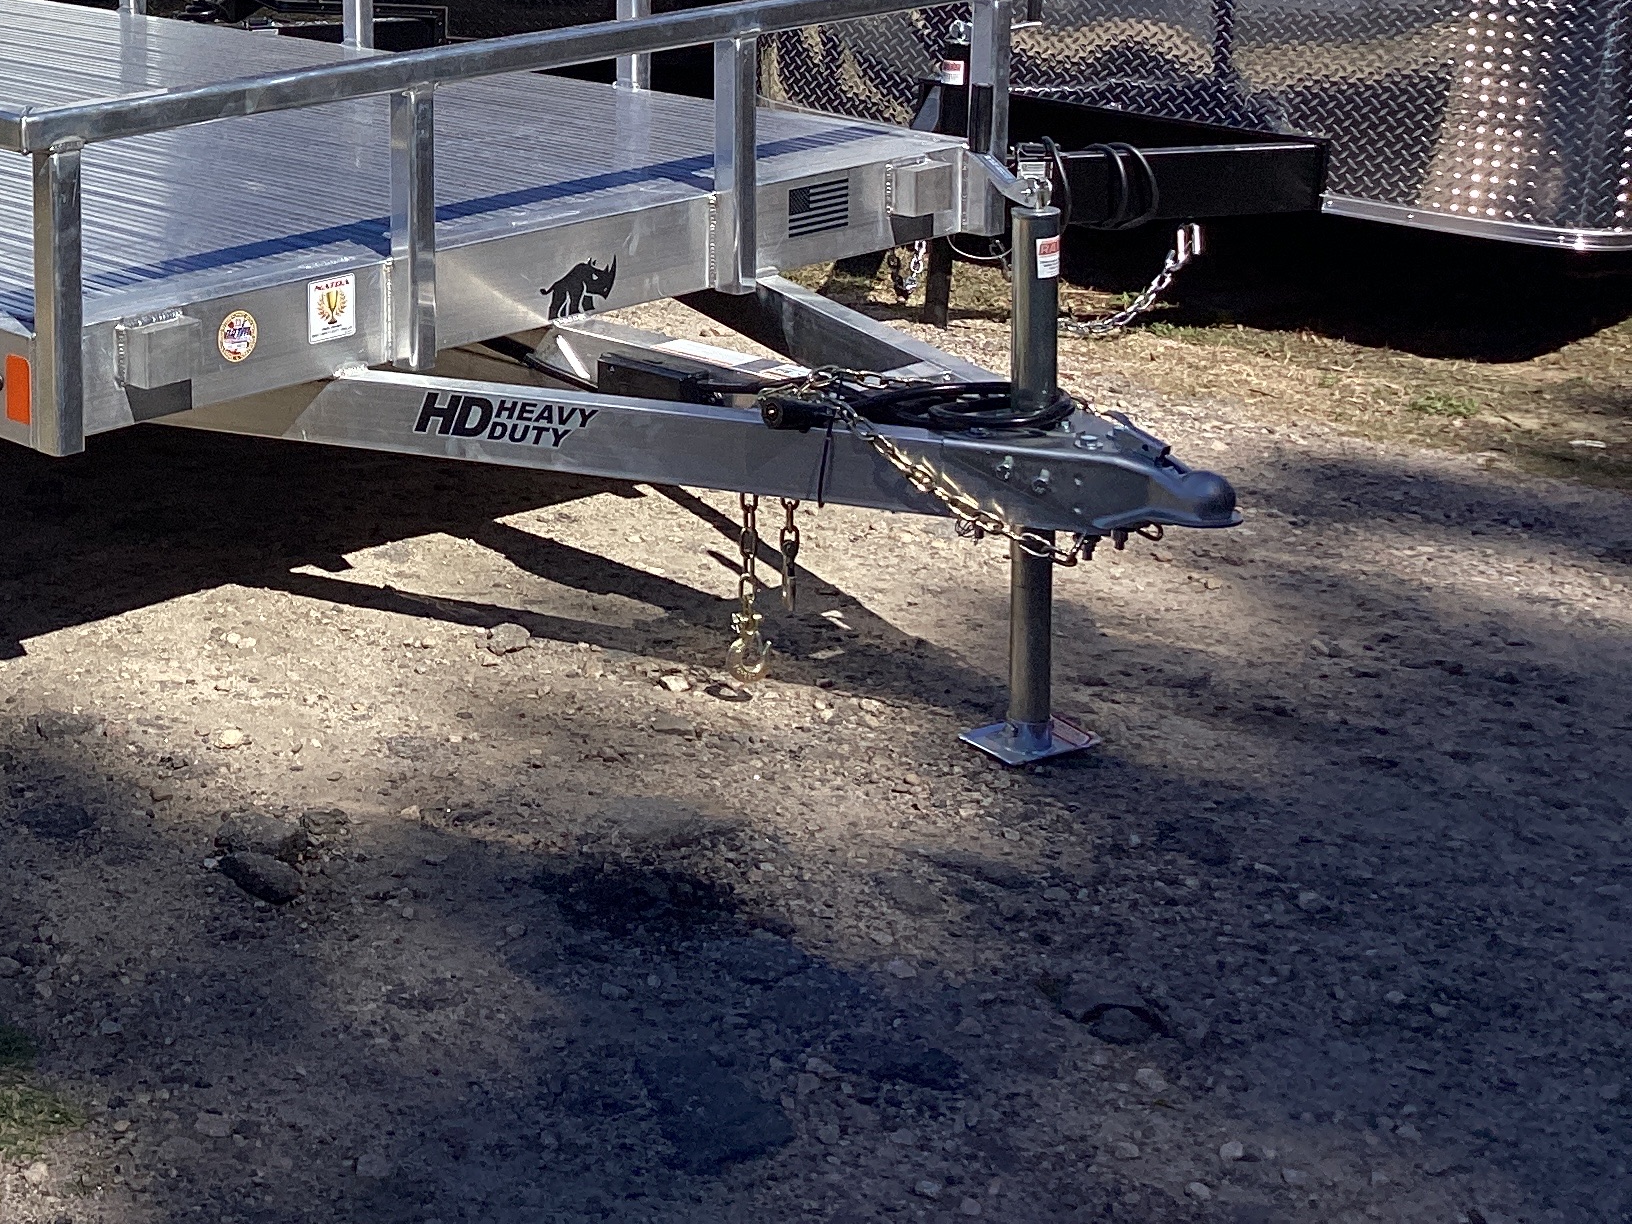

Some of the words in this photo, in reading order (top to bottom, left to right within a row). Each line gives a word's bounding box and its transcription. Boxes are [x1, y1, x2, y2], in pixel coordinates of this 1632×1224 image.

[413, 391, 494, 438] HD
[494, 399, 599, 428] HEAVY
[486, 421, 571, 448] DUTY
